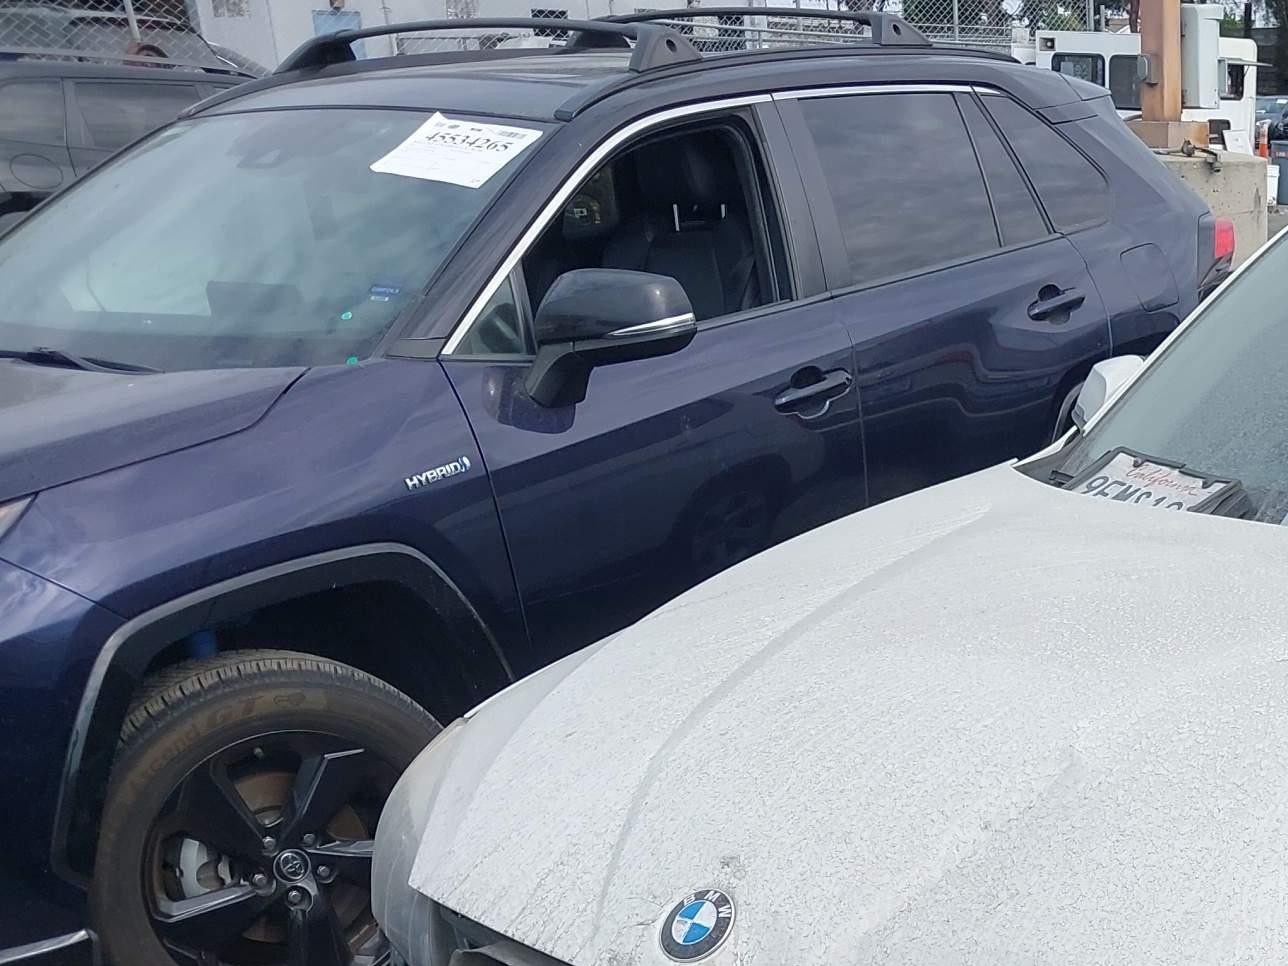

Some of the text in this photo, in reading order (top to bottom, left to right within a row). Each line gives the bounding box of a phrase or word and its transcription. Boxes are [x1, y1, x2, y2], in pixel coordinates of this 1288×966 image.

[425, 131, 515, 152] 45534265
[405, 461, 461, 490] HYBRID
[683, 890, 732, 918] BMW
